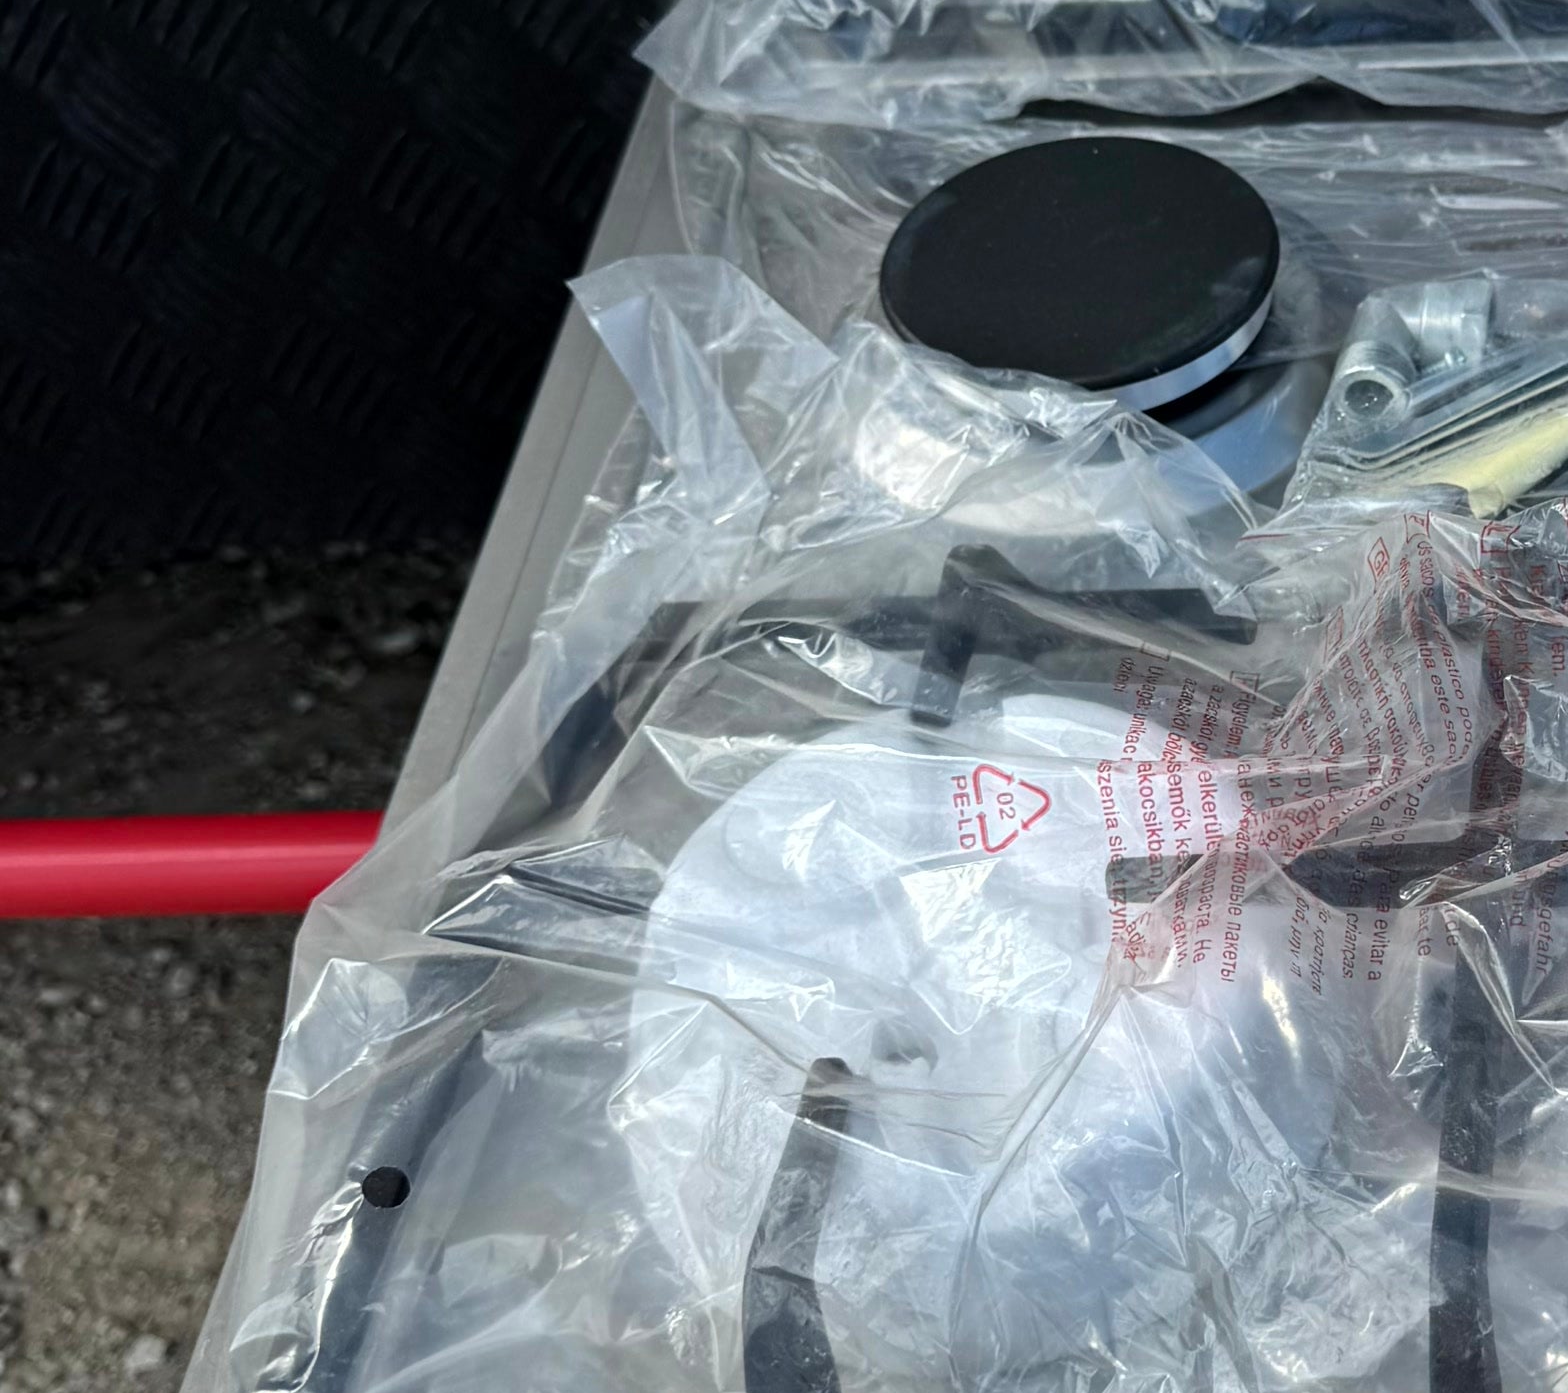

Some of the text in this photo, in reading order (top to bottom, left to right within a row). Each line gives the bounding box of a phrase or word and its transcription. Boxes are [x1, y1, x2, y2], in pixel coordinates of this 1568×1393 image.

[1430, 674, 1451, 714] este
[951, 775, 977, 850] PE-LD
[996, 792, 1017, 820] 02
[1193, 939, 1212, 963] Не
[1220, 920, 1243, 983] пакеты
[1368, 919, 1390, 965] evitar
